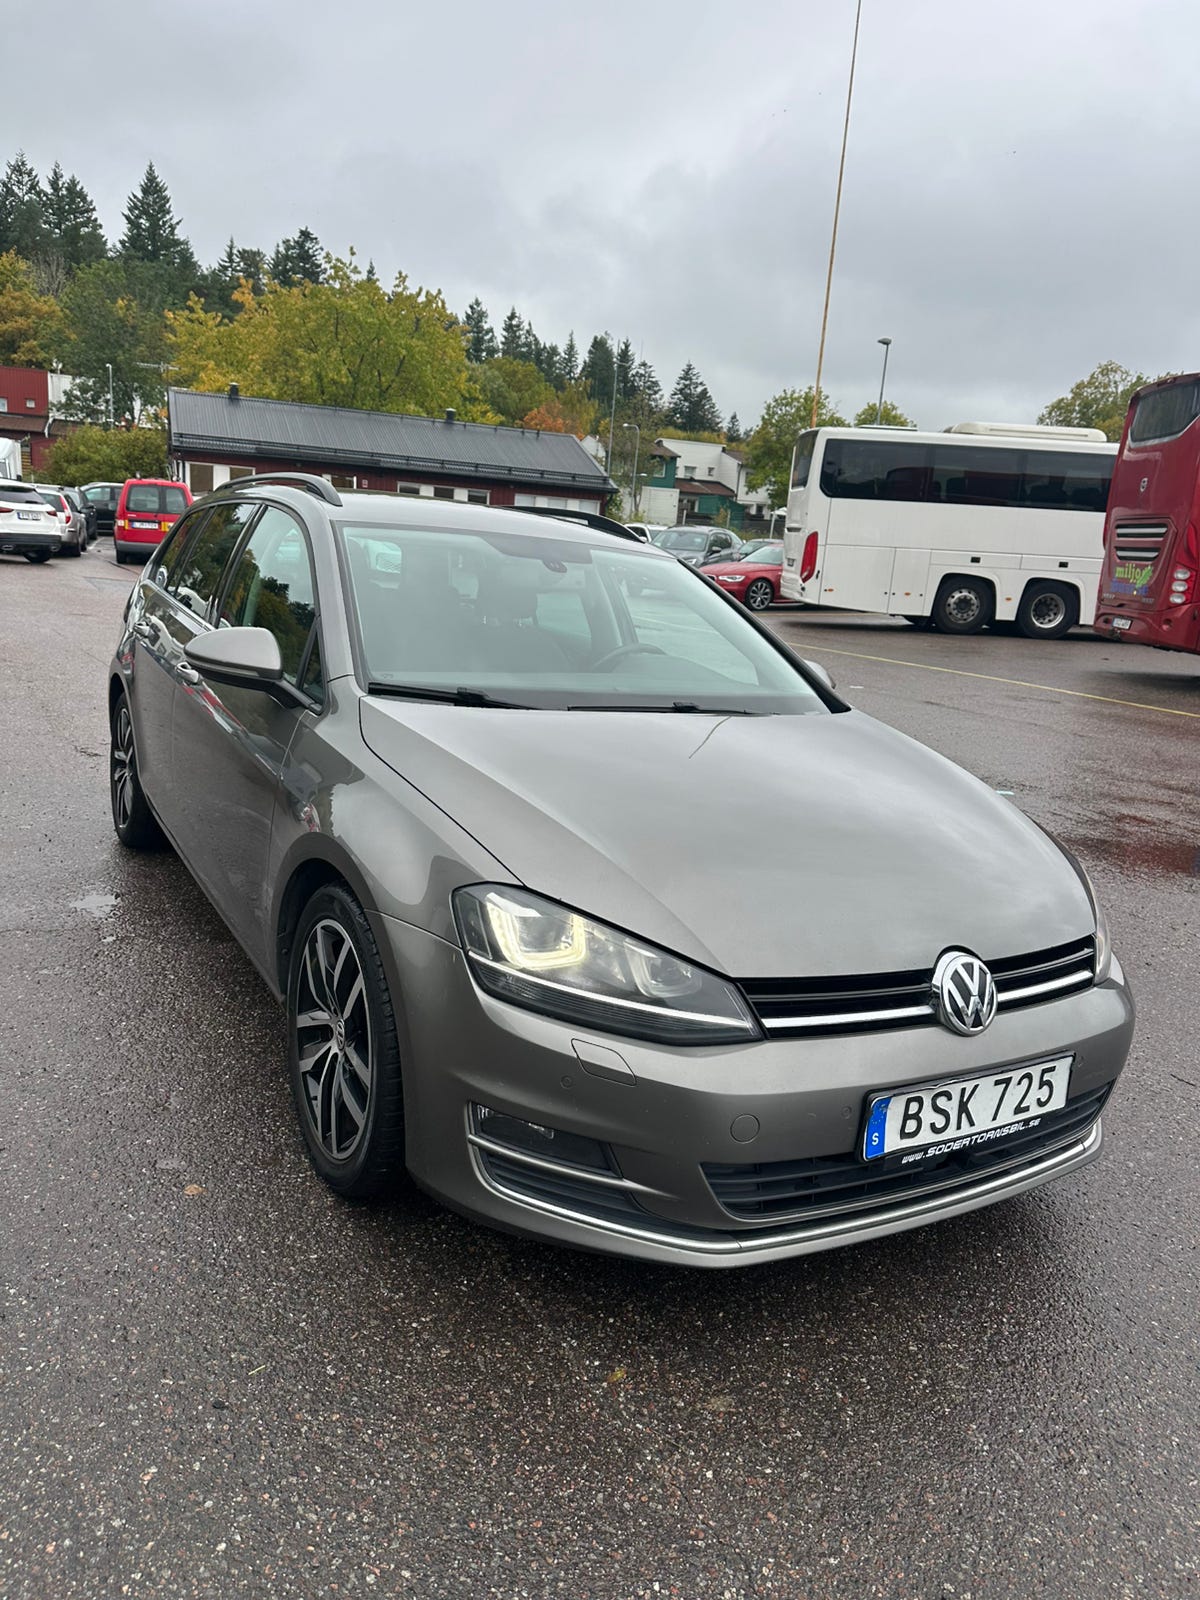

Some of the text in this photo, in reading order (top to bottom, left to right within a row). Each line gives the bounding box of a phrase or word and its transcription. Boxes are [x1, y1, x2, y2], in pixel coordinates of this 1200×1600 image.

[900, 1066, 1057, 1140] BSK 725
[871, 1132, 879, 1146] S
